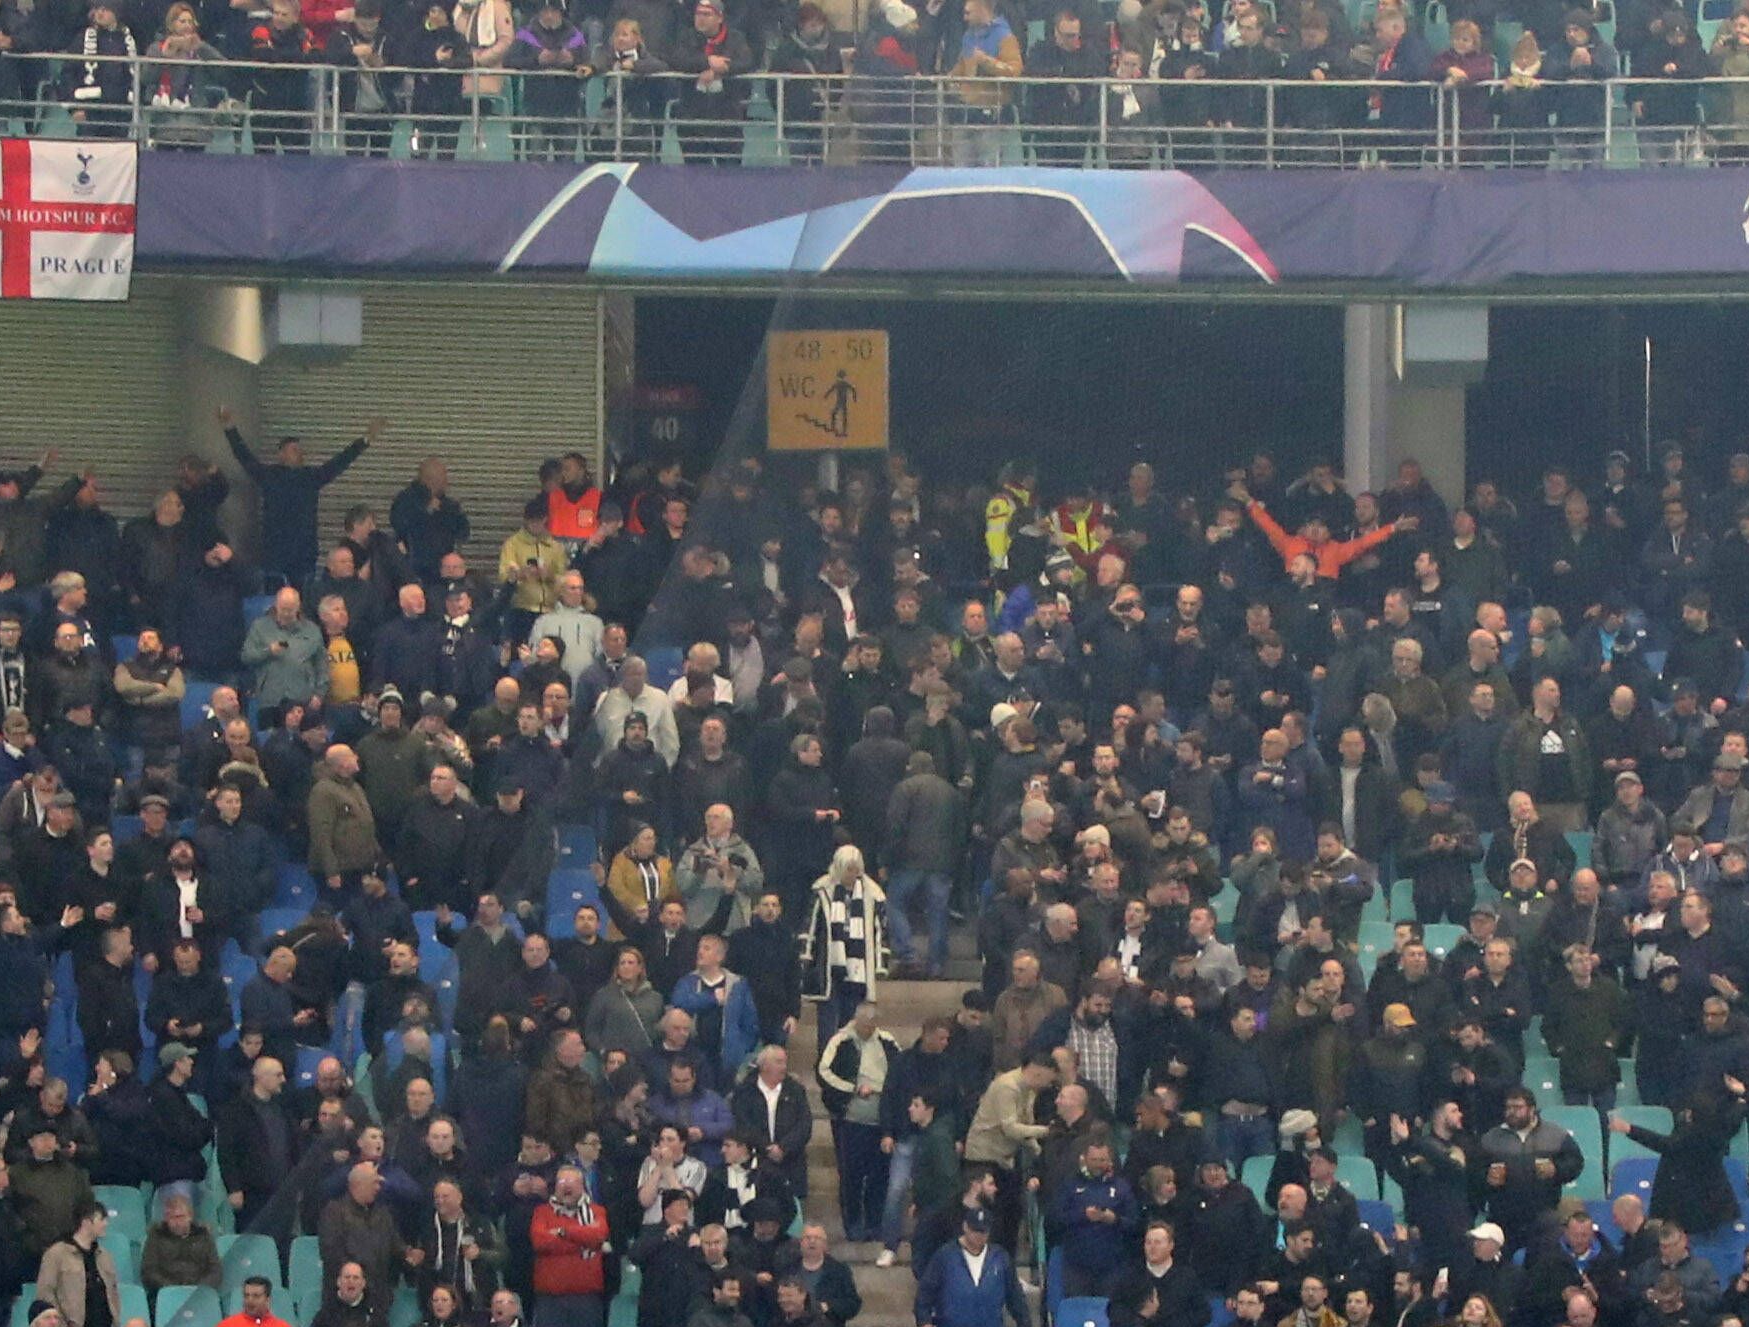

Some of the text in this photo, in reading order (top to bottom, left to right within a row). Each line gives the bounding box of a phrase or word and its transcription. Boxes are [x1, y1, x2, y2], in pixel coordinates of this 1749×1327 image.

[17, 206, 95, 225] HOTSPUR
[40, 256, 126, 275] PRAGUE
[779, 376, 816, 398] WC
